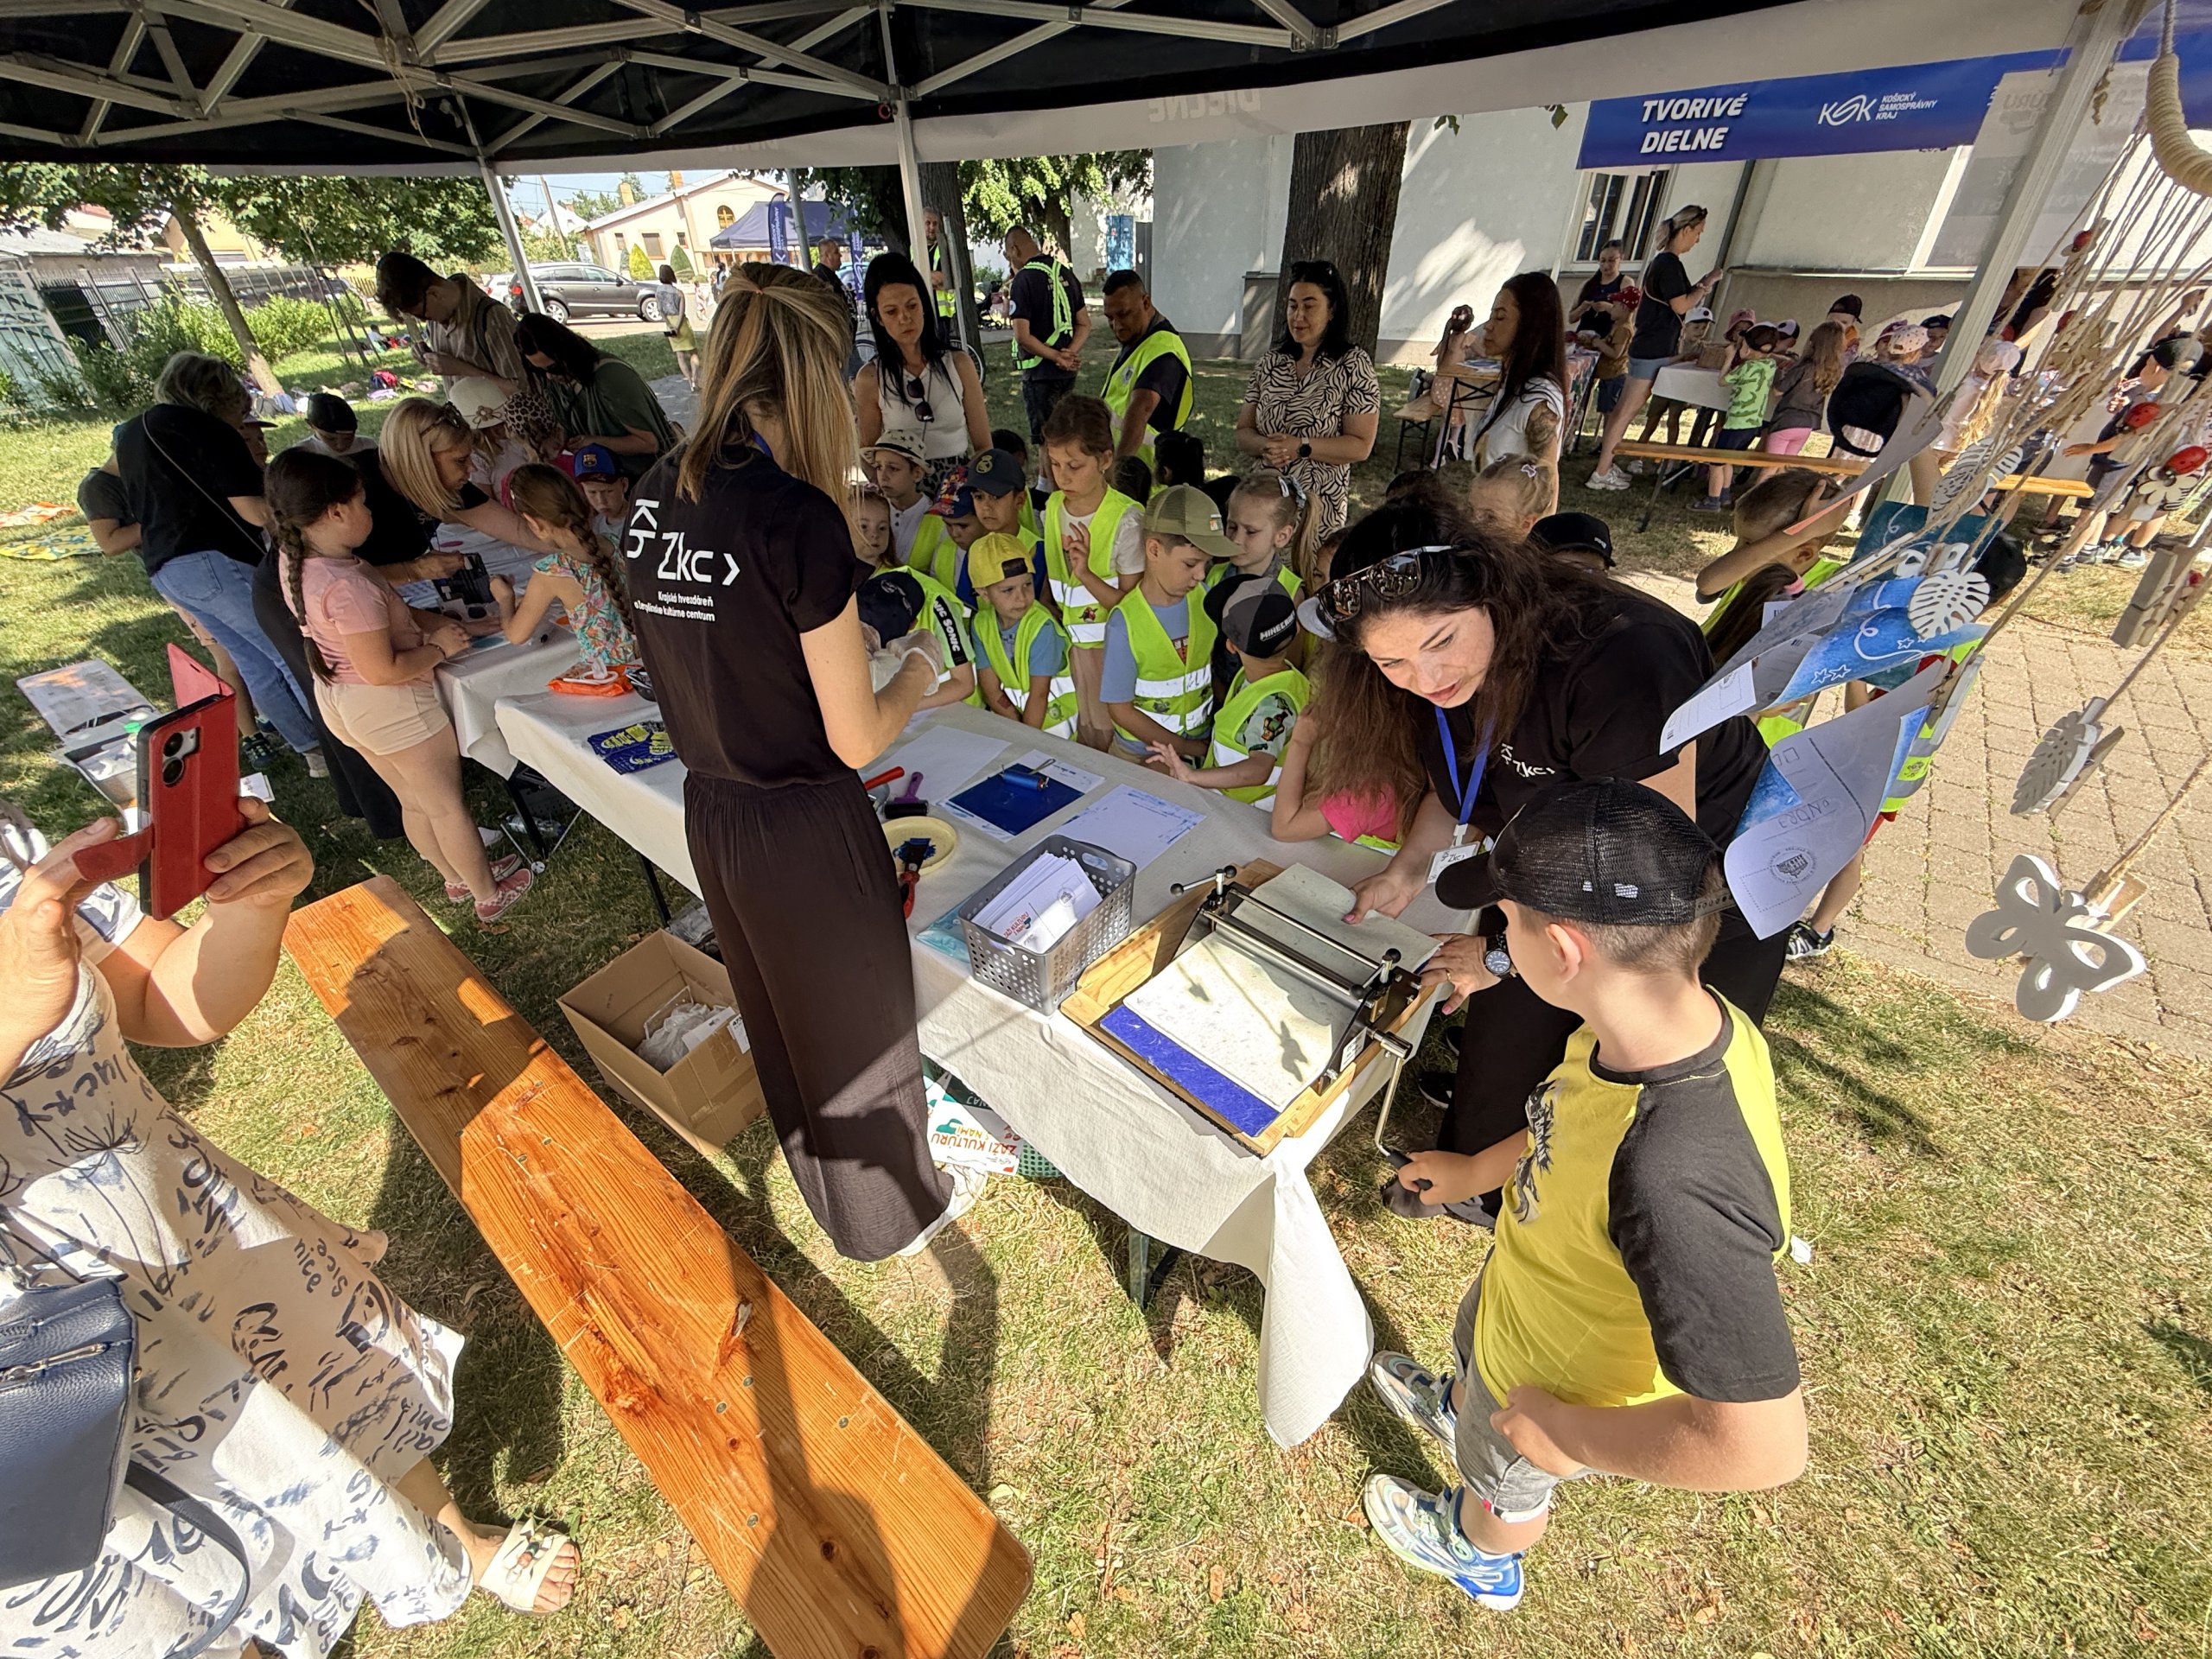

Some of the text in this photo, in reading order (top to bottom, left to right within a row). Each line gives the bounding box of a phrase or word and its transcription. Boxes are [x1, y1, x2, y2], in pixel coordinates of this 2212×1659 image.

[1878, 99, 1938, 111] SAMOSPRÁVNY
[1882, 91, 1916, 103] KOŠICKÝ
[1642, 92, 1748, 123] TVORIVÉ
[1875, 111, 1897, 120] KRAJ
[1640, 127, 1729, 154] DIELNE
[686, 610, 715, 622] centrum
[944, 619, 960, 652] SONIC
[1535, 1116, 1547, 1163] BATMAN
